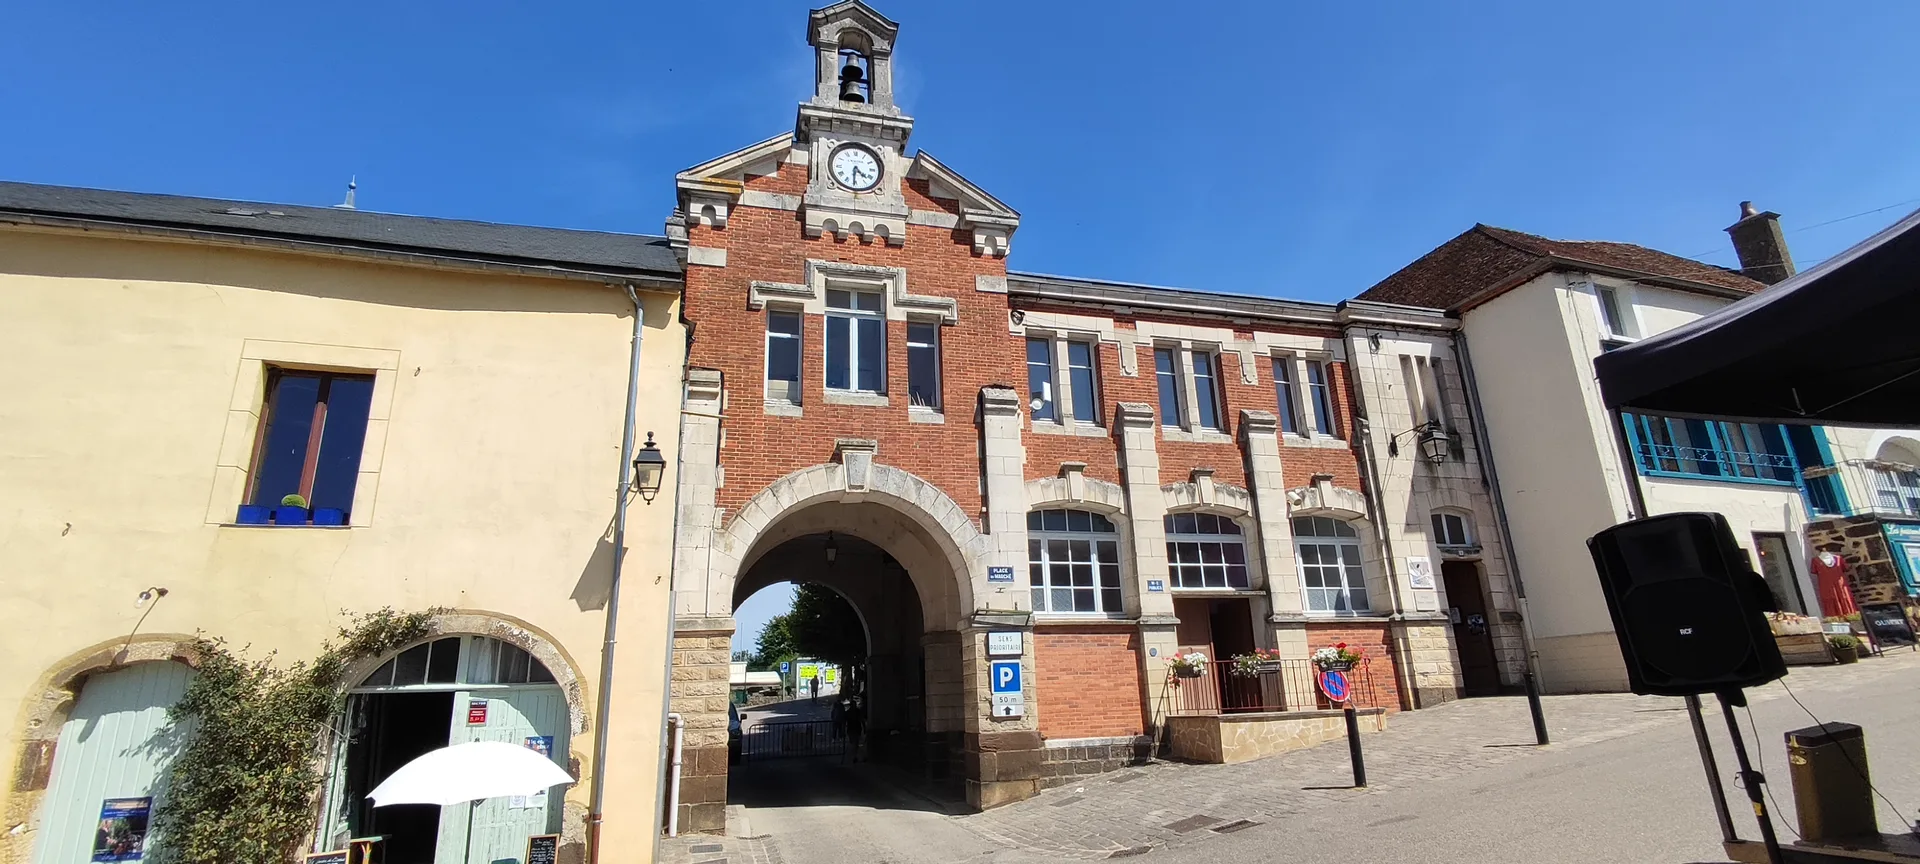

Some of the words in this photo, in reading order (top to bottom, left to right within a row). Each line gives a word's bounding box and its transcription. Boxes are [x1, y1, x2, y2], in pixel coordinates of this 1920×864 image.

[1875, 618, 1904, 626] OUVERT
[1680, 627, 1692, 635] RCF
[1000, 666, 1014, 688] P
